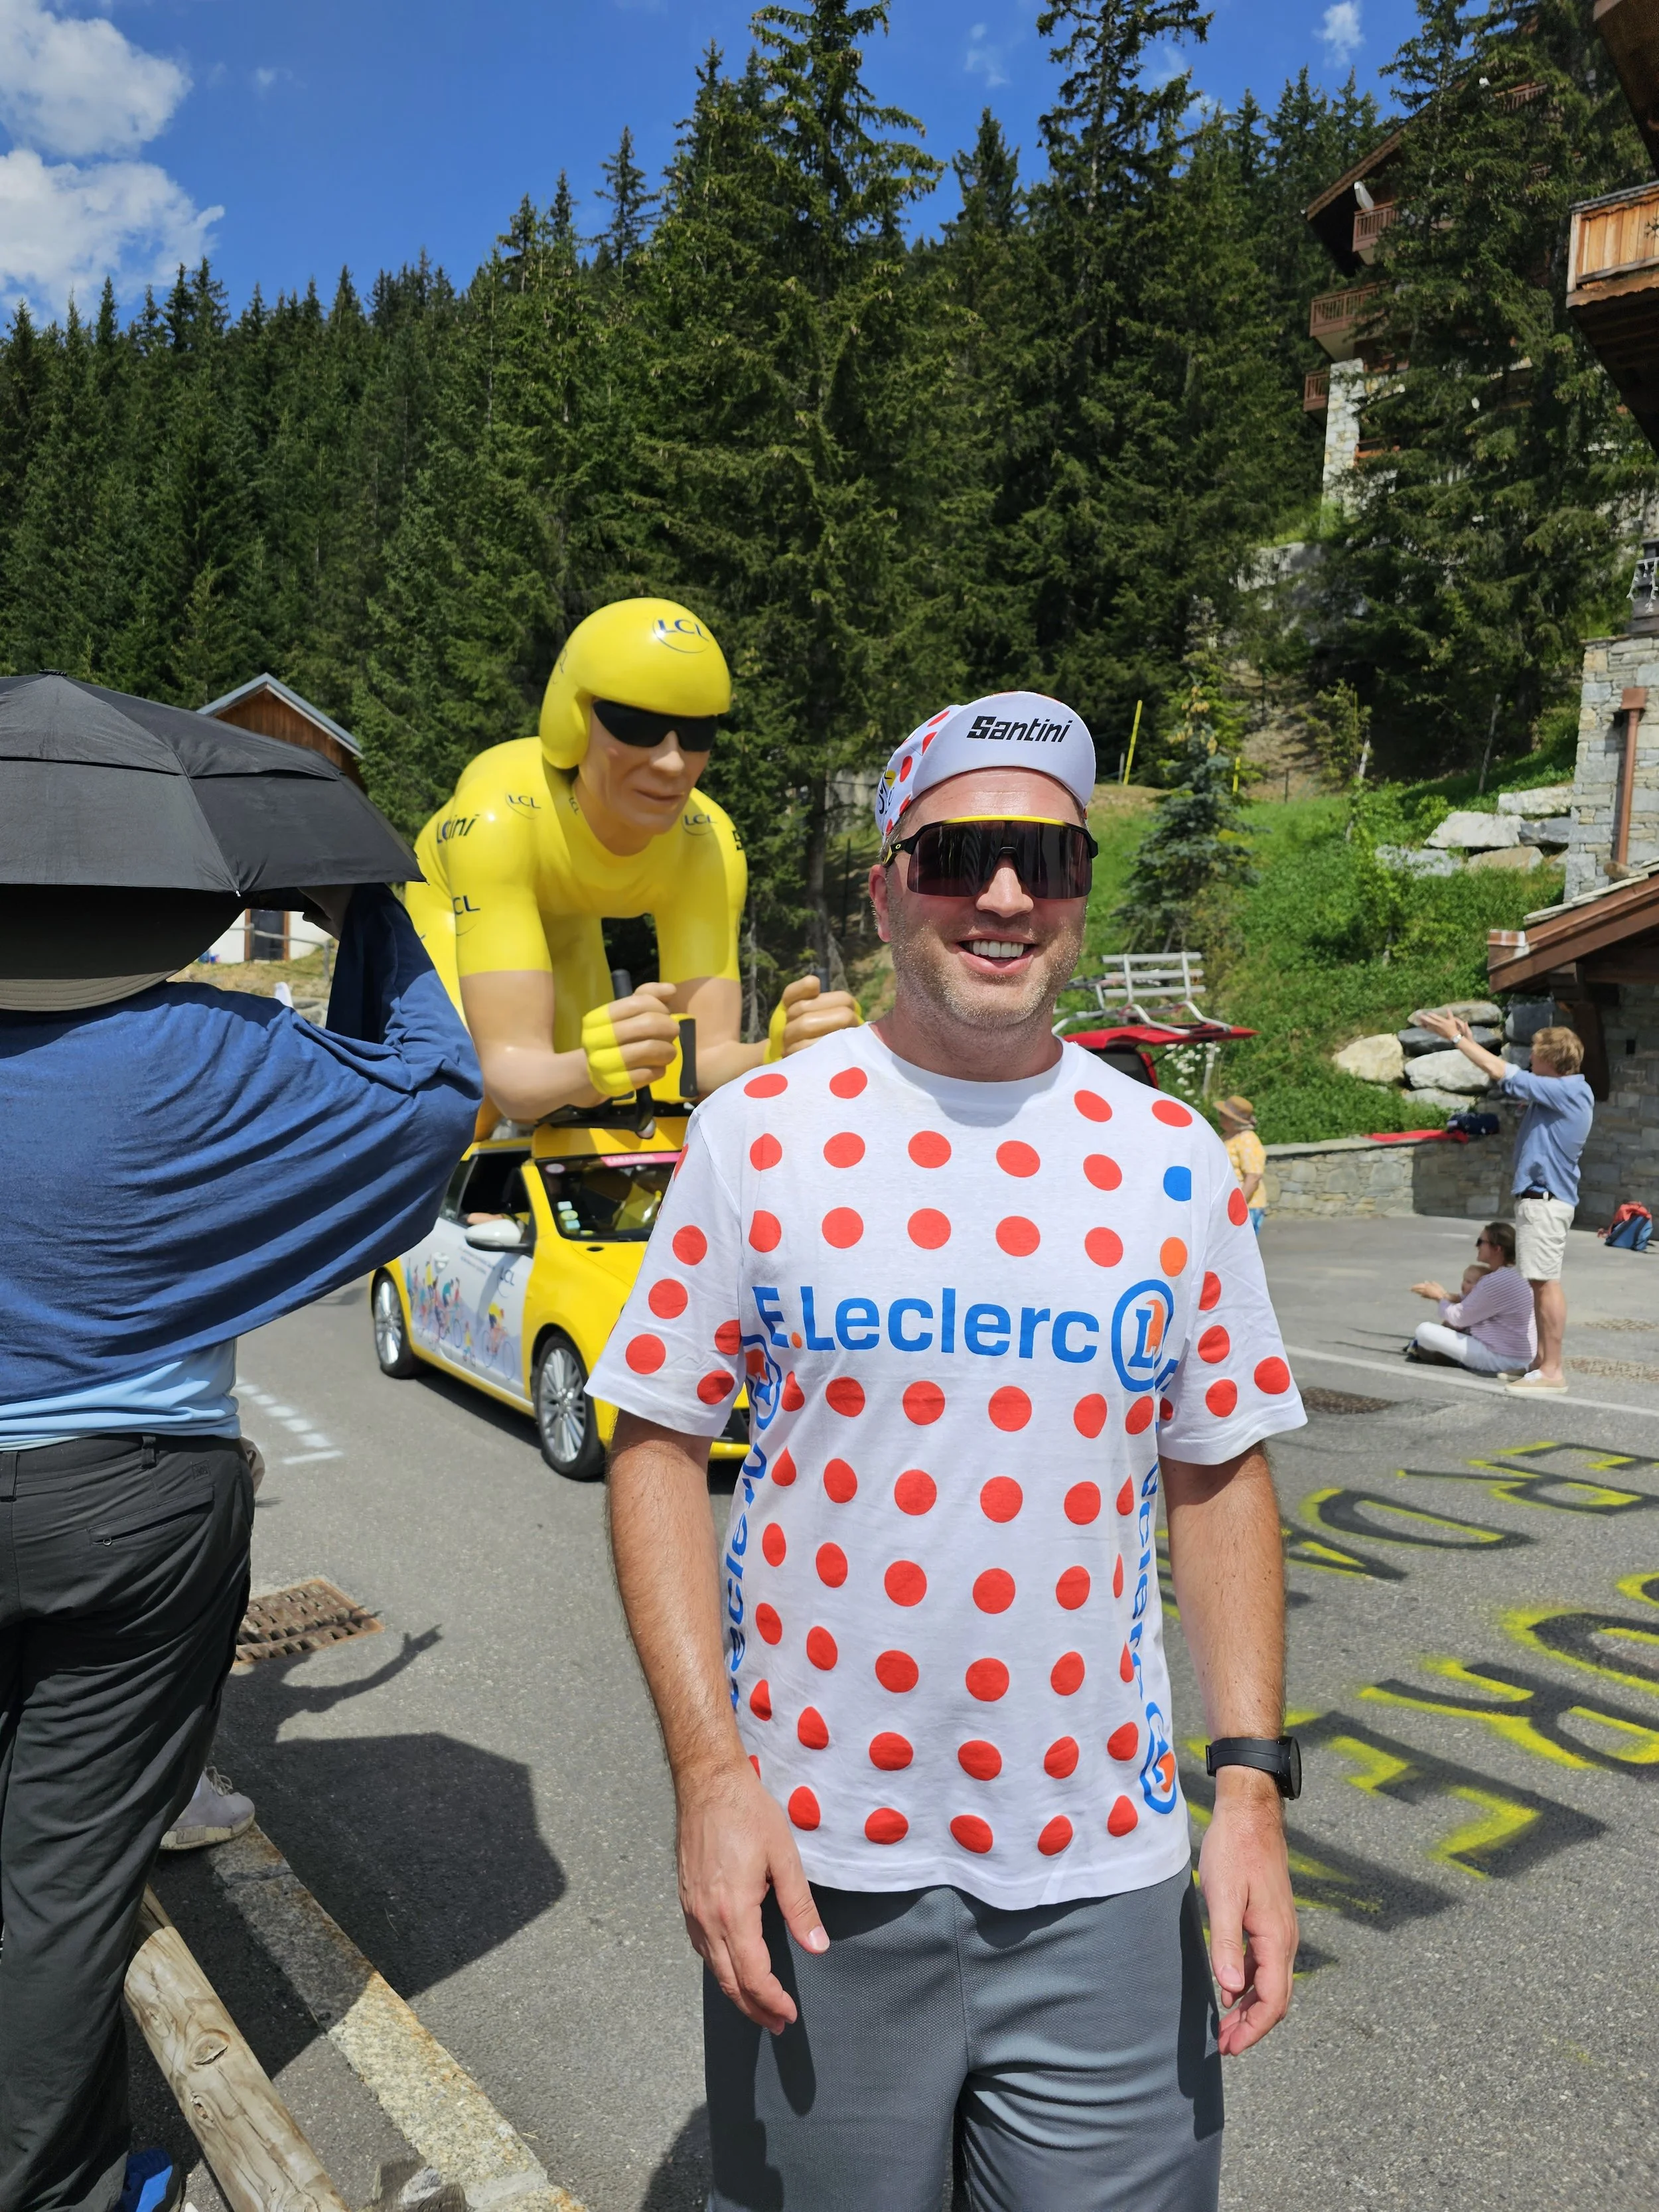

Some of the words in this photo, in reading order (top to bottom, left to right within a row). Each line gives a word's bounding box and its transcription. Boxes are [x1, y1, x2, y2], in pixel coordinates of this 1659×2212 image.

[658, 619, 709, 642] LCL
[966, 715, 1073, 743] Santini
[508, 794, 541, 809] LCL
[684, 814, 717, 826] LCL
[454, 895, 480, 916] CL
[500, 1267, 516, 1287] LCL
[751, 1285, 1100, 1364] E.Leclerc
[1129, 1460, 1159, 1700] eclerc
